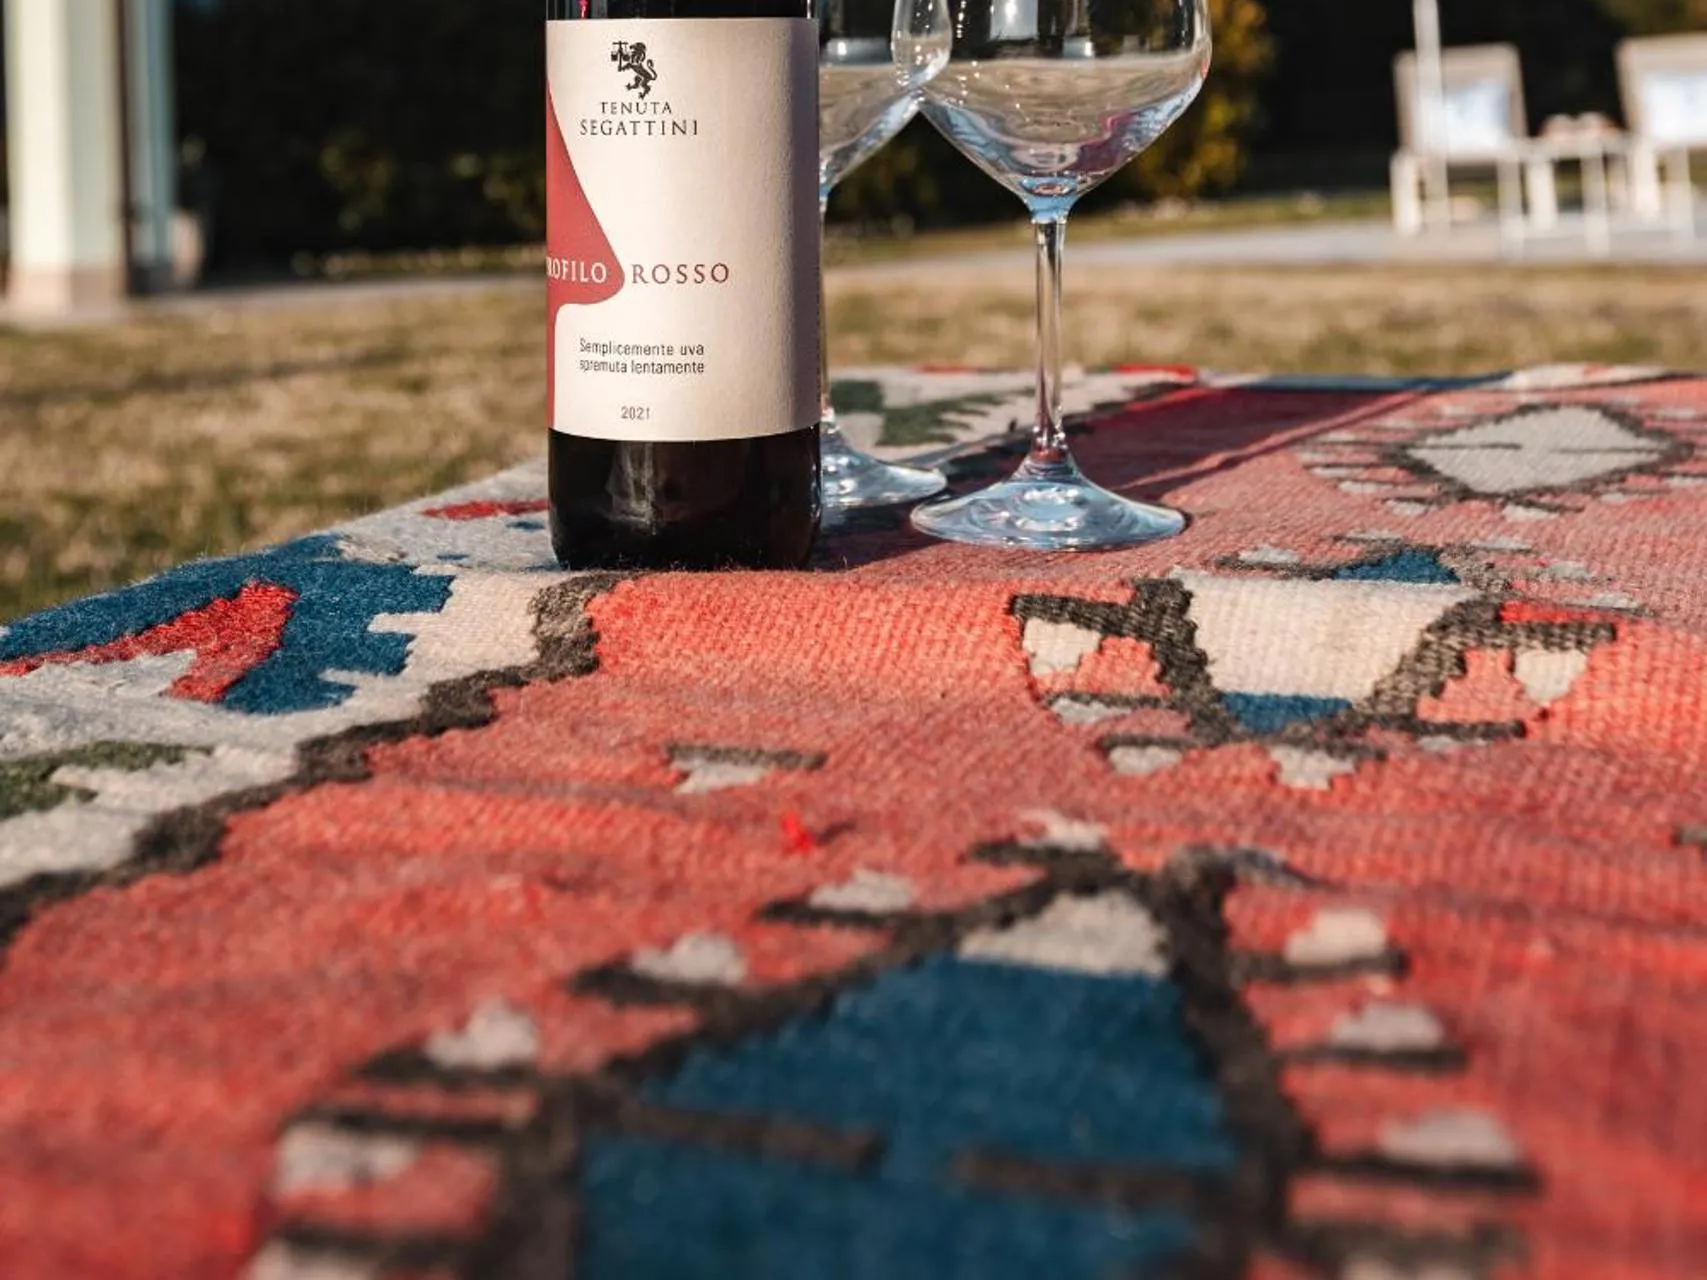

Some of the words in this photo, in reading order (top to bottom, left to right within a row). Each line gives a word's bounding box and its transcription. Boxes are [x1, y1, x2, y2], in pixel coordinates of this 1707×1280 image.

[600, 102, 672, 114] TENUTA
[579, 119, 698, 135] SEGATTINI
[632, 262, 730, 285] ROSSO
[579, 338, 674, 357] Semplicemente
[680, 345, 704, 356] uva
[579, 359, 627, 373] spremuta
[631, 360, 705, 374] lentamente
[621, 406, 650, 420] 2021
